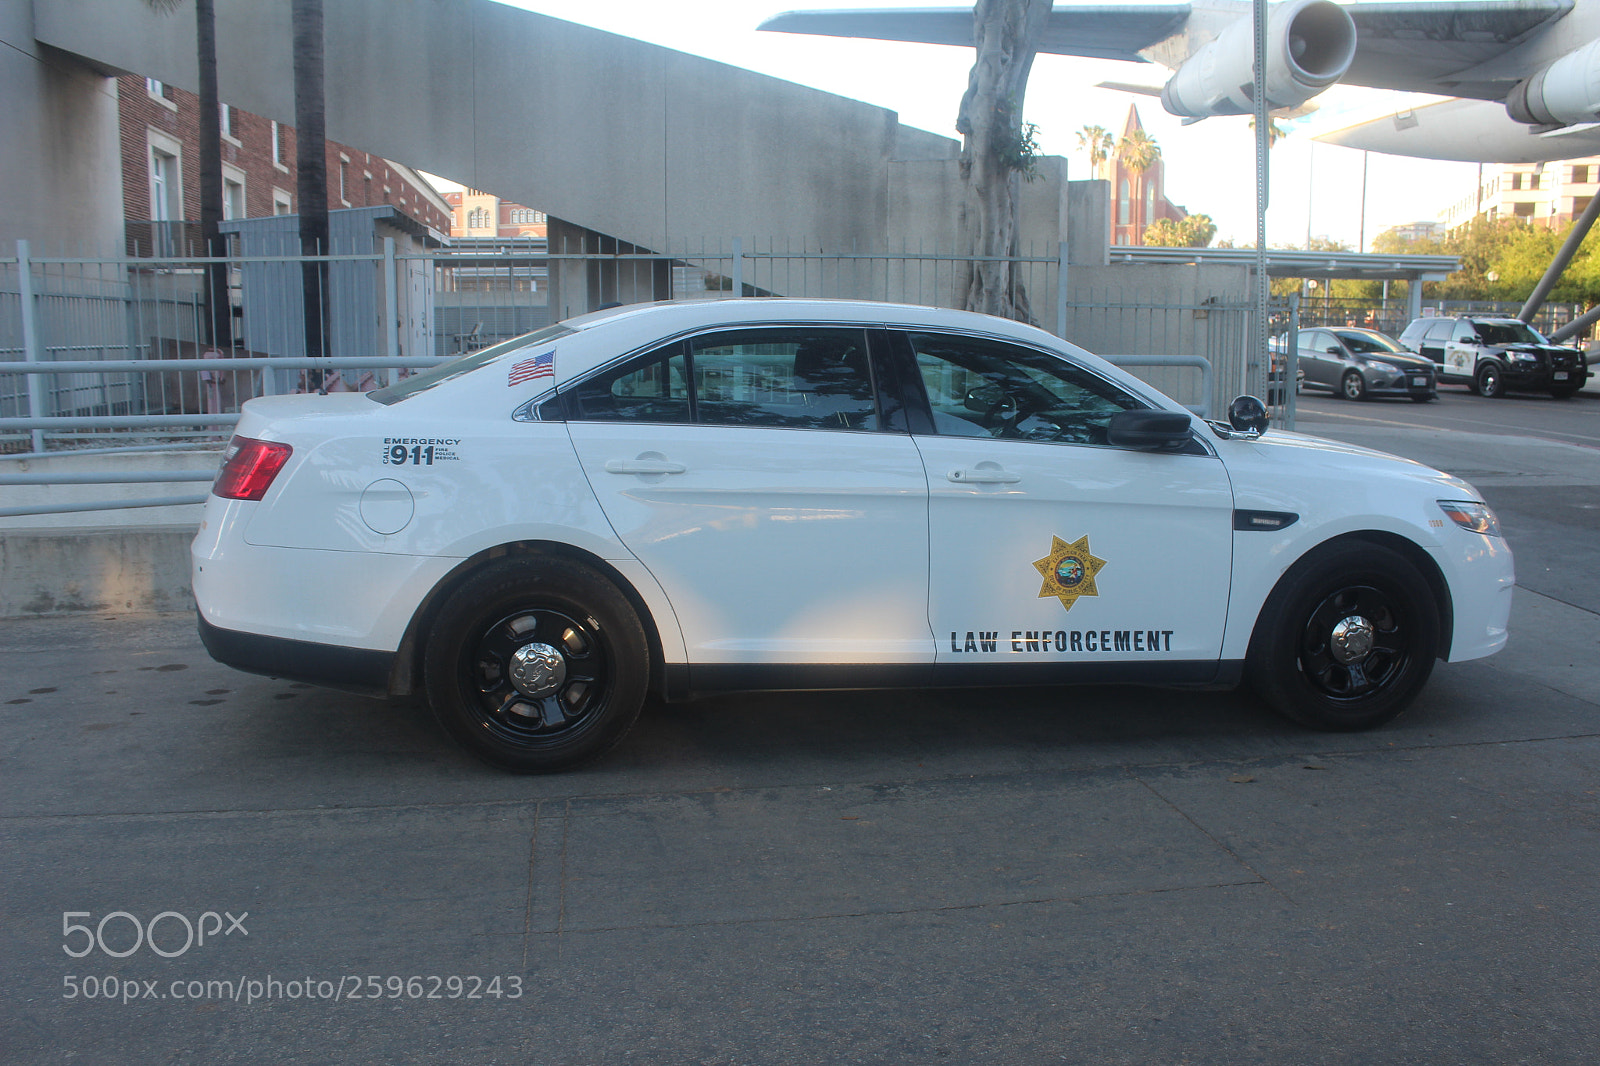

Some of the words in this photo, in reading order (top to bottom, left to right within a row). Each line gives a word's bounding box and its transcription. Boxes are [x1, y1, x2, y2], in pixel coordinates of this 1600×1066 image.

[384, 437, 461, 445] EMERGENCY
[951, 631, 999, 653] LAW
[1011, 630, 1174, 653] ENFORCEMENT
